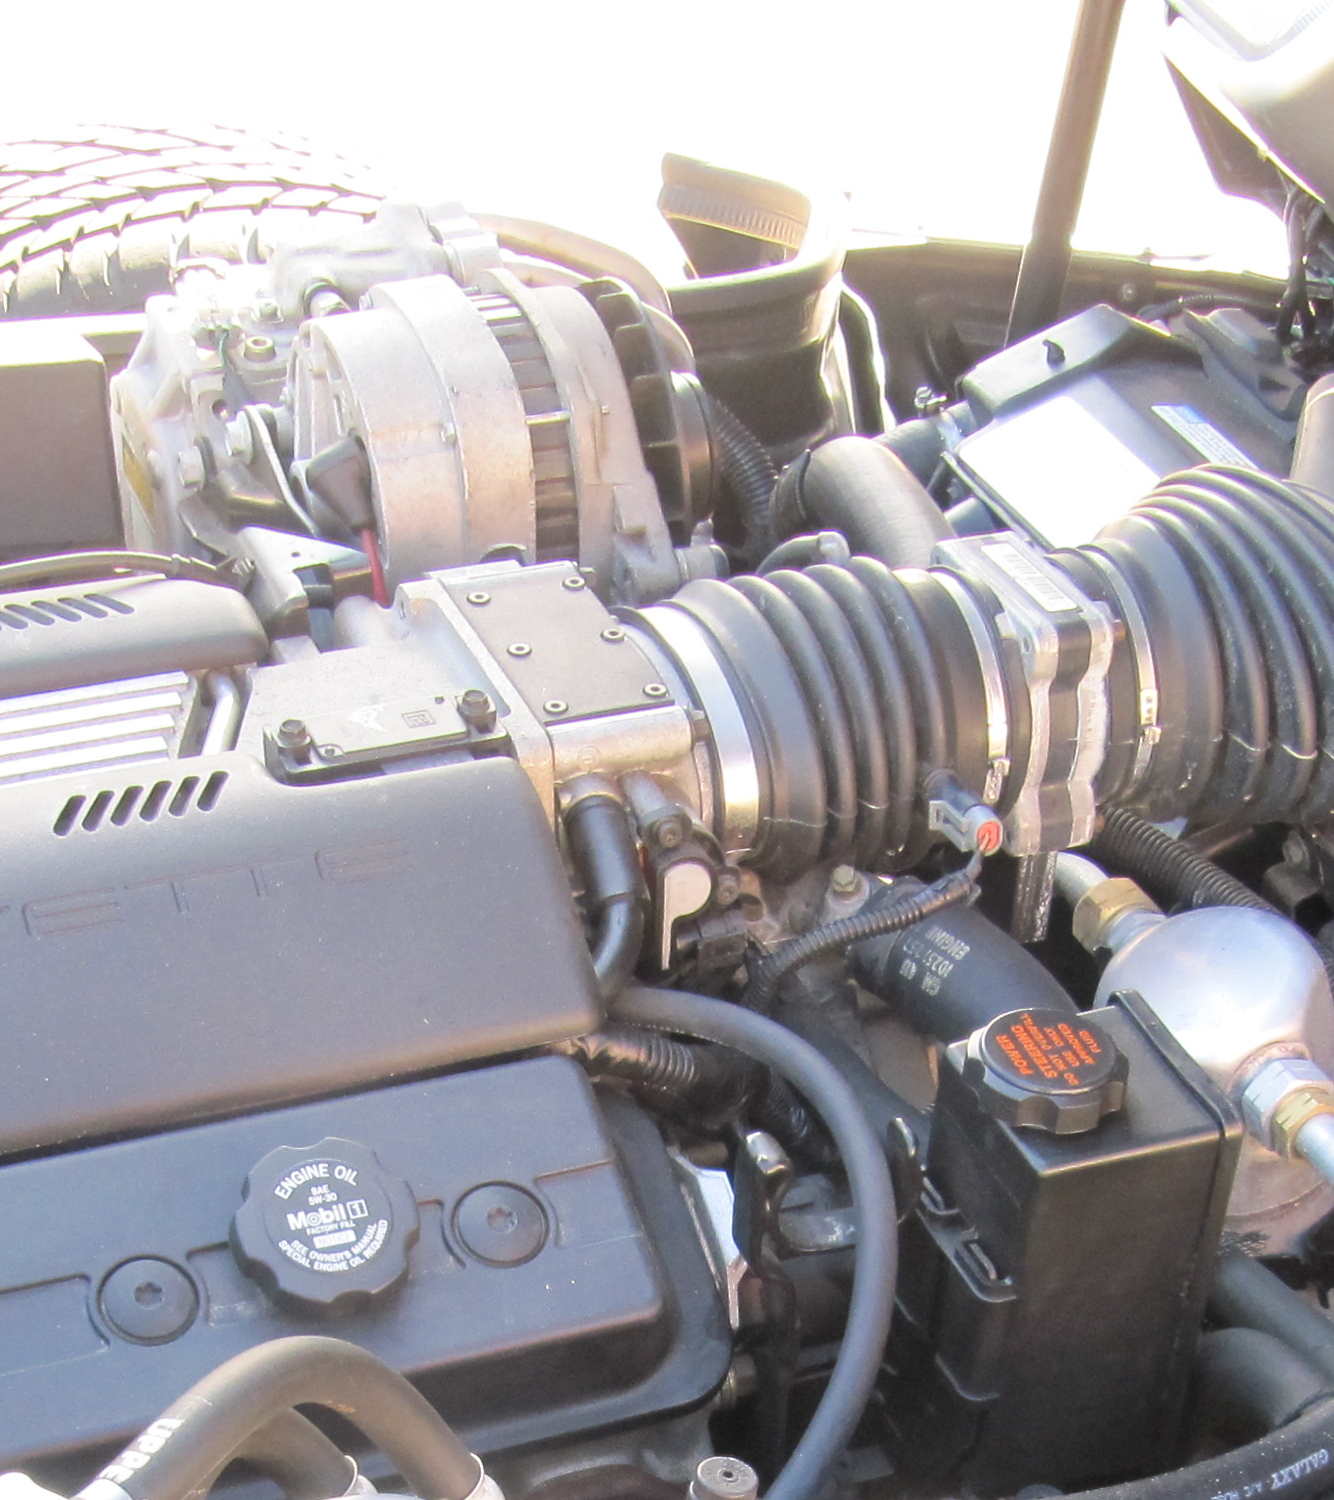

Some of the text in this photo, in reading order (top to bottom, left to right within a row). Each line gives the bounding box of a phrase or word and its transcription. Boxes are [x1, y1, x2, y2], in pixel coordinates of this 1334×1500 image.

[995, 1034, 1035, 1075] POWER
[1011, 1024, 1059, 1079] STEERING
[1043, 1027, 1081, 1068] USE ONLY
[1057, 1023, 1097, 1065] APPROVED
[1078, 1030, 1102, 1053] FLUID
[1048, 1054, 1068, 1071] NOT
[1064, 1072, 1081, 1086] DO
[274, 1163, 359, 1200] ENGINE OIL
[310, 1184, 331, 1196] SAE
[308, 1192, 338, 1206] 5W-30
[287, 1203, 347, 1230] Mobil
[306, 1220, 356, 1236] FACTORY FILL
[278, 1219, 389, 1272] SPECIAL ENGINE OIL REQUIRED
[291, 1222, 378, 1263] SEE OWNER'S MANUAL
[1270, 1448, 1329, 1490] GALAXY
[1243, 1480, 1264, 1498] A/C
